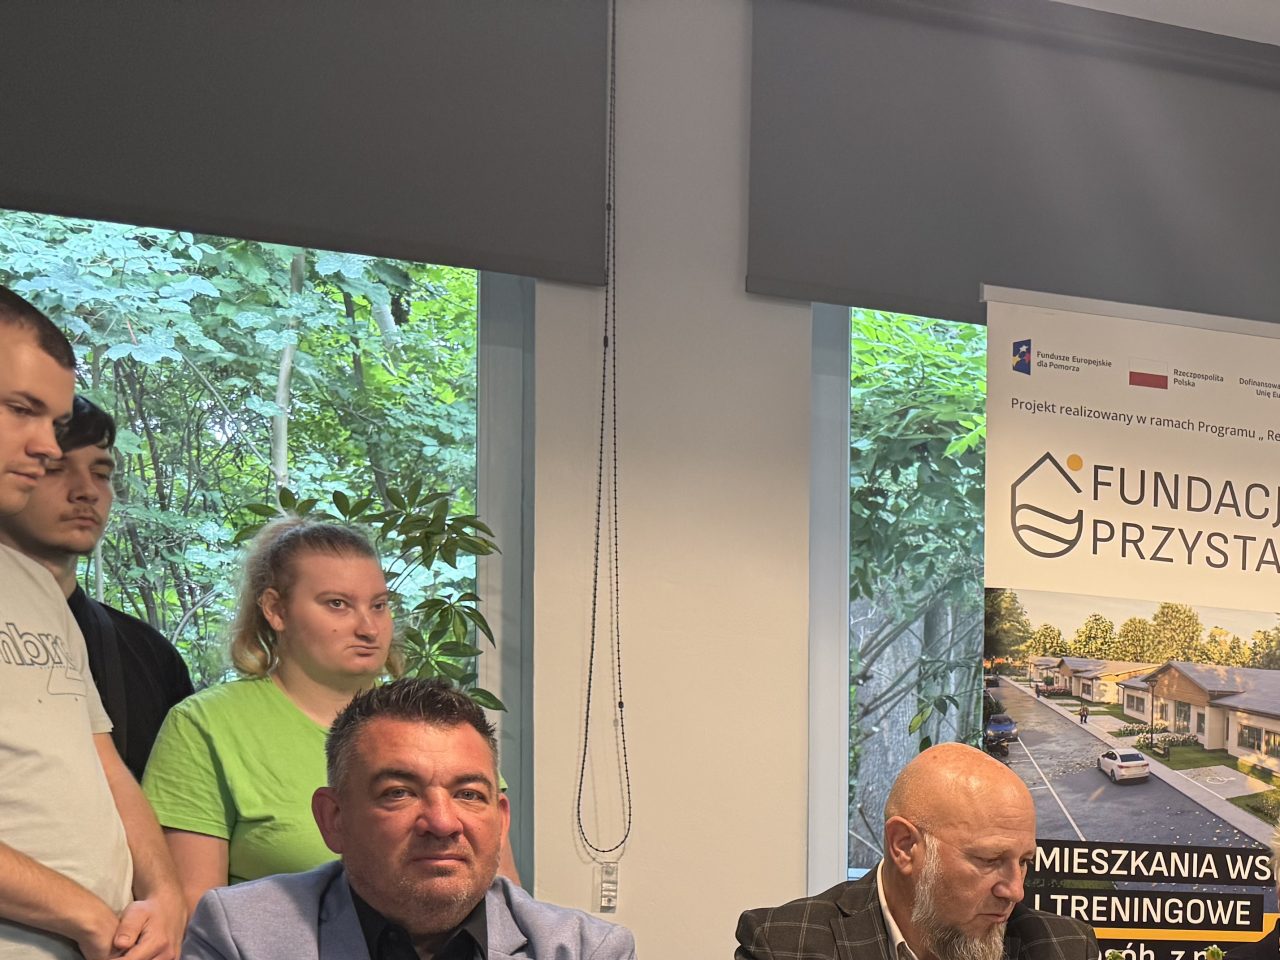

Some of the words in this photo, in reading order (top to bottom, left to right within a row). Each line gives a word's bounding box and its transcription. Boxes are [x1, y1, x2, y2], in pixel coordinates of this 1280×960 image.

[1036, 351, 1070, 362] Fundusze
[1072, 355, 1113, 368] Europejskie
[1036, 360, 1048, 368] dla
[1049, 361, 1081, 372] Pomorza
[1173, 368, 1224, 383] Rzeczpospolita
[1173, 378, 1196, 388] Polska
[1011, 397, 1056, 414] Projekt
[1059, 404, 1133, 426] realizowany
[1136, 415, 1147, 424] w
[1150, 416, 1194, 431] ramach
[1198, 421, 1255, 438] Programu
[1035, 847, 1219, 879] MIESZKANIA
[1050, 894, 1251, 926] TRENINGOWE
